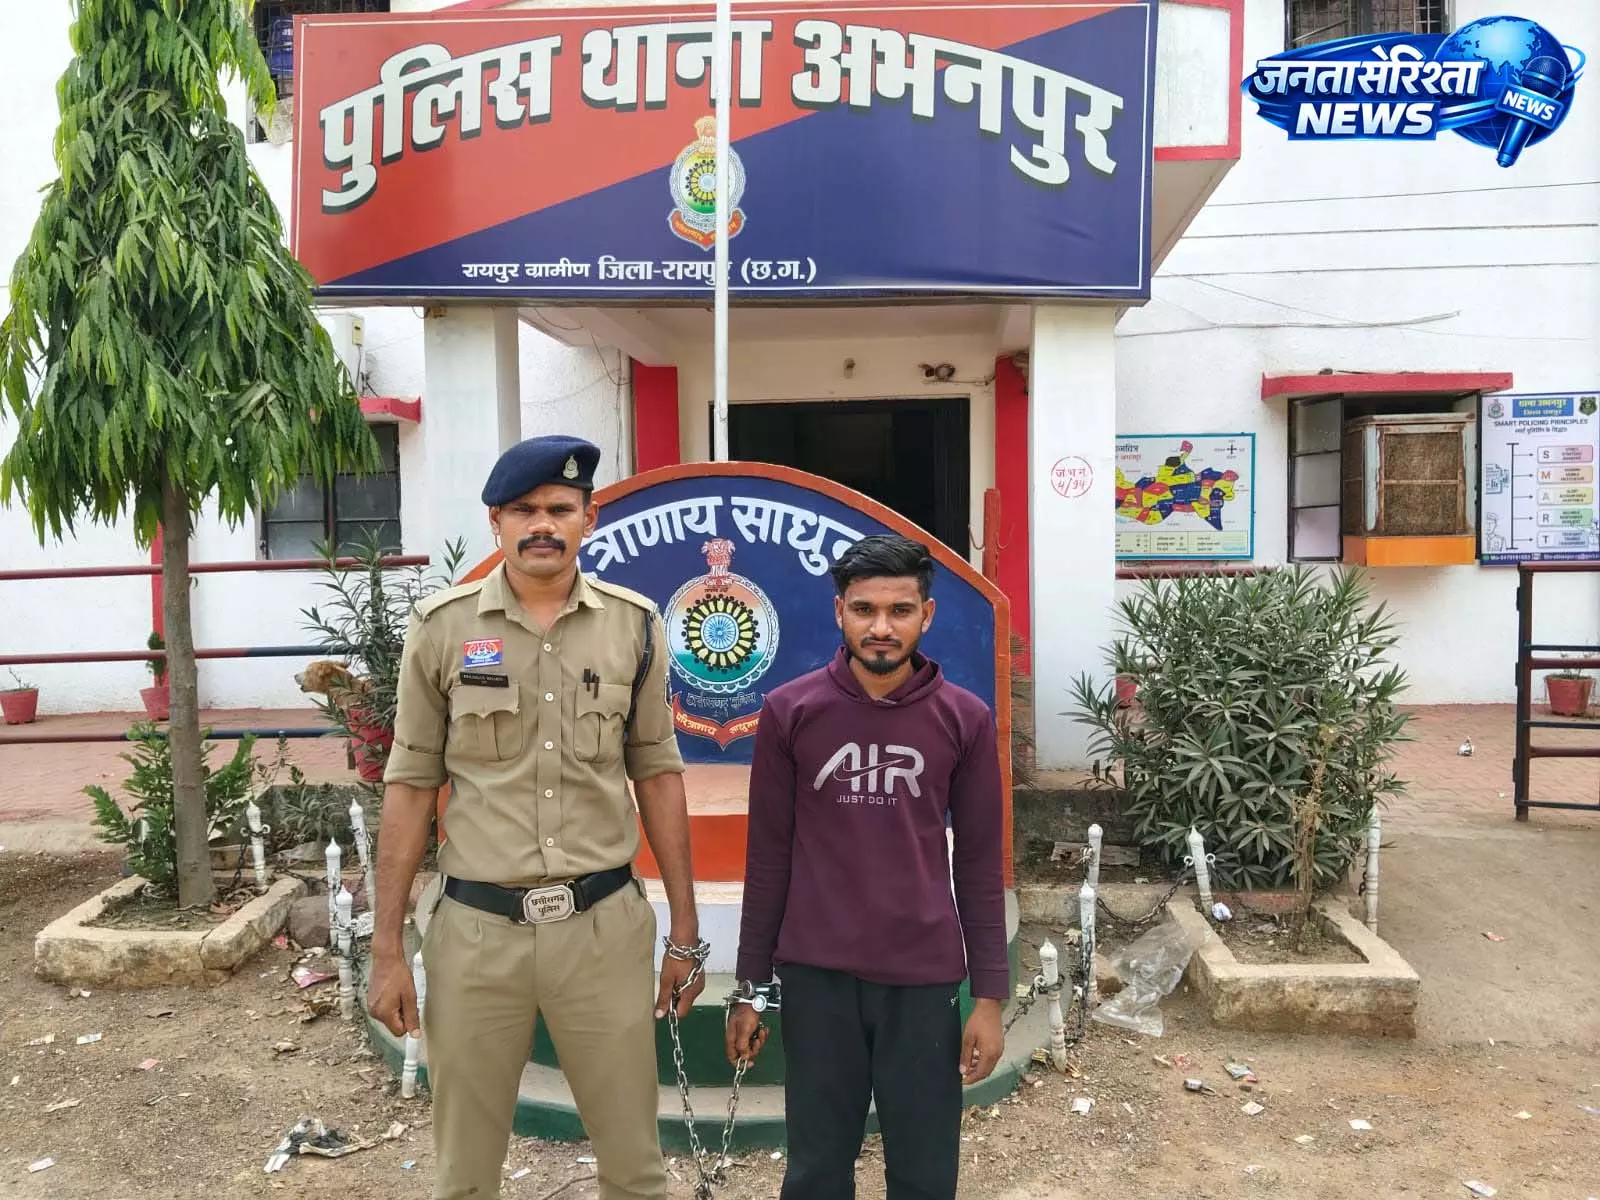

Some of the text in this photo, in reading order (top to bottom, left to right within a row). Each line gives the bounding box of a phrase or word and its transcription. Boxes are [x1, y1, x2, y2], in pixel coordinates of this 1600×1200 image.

[319, 19, 1124, 213] पुलिस थाना अभनपुर
[461, 255, 817, 285] रायपुर ग्रामीण जिला-रायपु (छ.ग.)
[1543, 450, 1550, 459] S
[1541, 471, 1551, 480] M
[1542, 513, 1549, 523] R
[577, 496, 723, 578] त्राणाय
[1541, 535, 1549, 544] T
[813, 742, 925, 798] AIR
[836, 794, 899, 806] JUST DO IT
